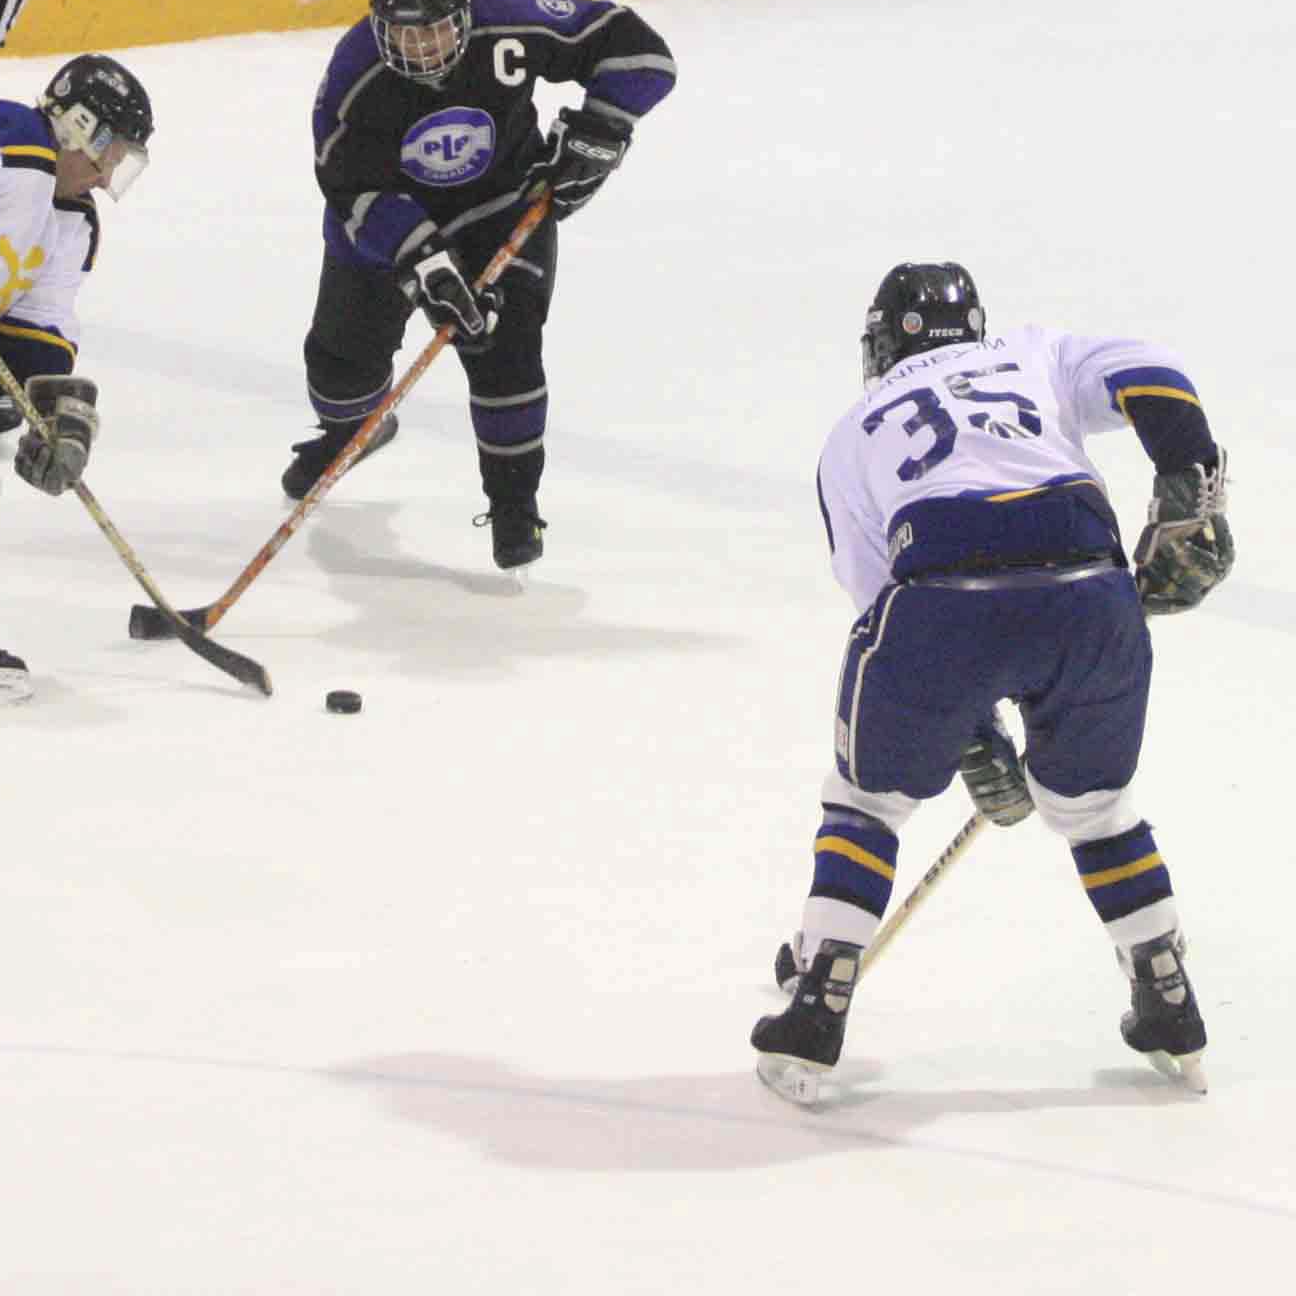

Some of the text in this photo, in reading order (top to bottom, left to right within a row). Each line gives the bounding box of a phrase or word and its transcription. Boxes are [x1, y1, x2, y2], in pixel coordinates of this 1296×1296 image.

[493, 38, 526, 86] C
[423, 134, 469, 162] PLP
[862, 362, 1042, 481] 35
